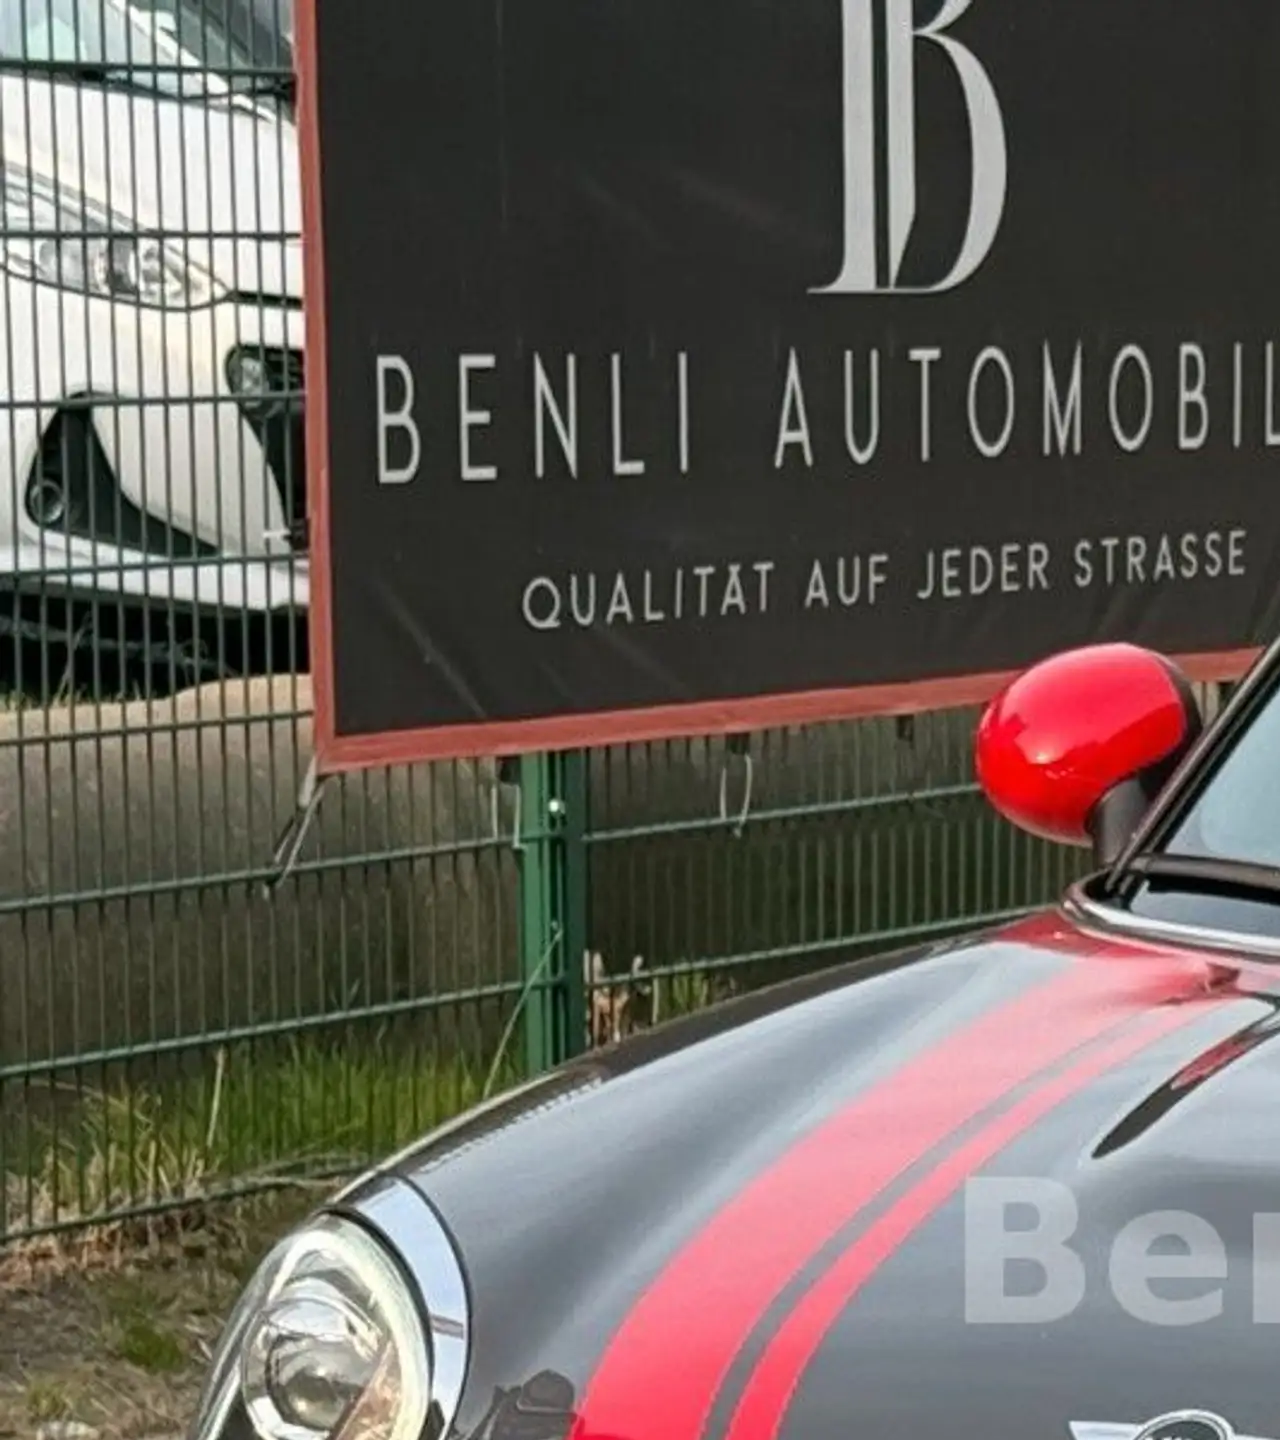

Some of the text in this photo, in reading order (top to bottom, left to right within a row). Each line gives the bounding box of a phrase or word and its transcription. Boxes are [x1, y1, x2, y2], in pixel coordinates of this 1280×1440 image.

[376, 350, 690, 484] BENLI
[804, 553, 890, 608] AUF
[915, 541, 1050, 600] JEDER
[1072, 529, 1247, 588] STRASSE
